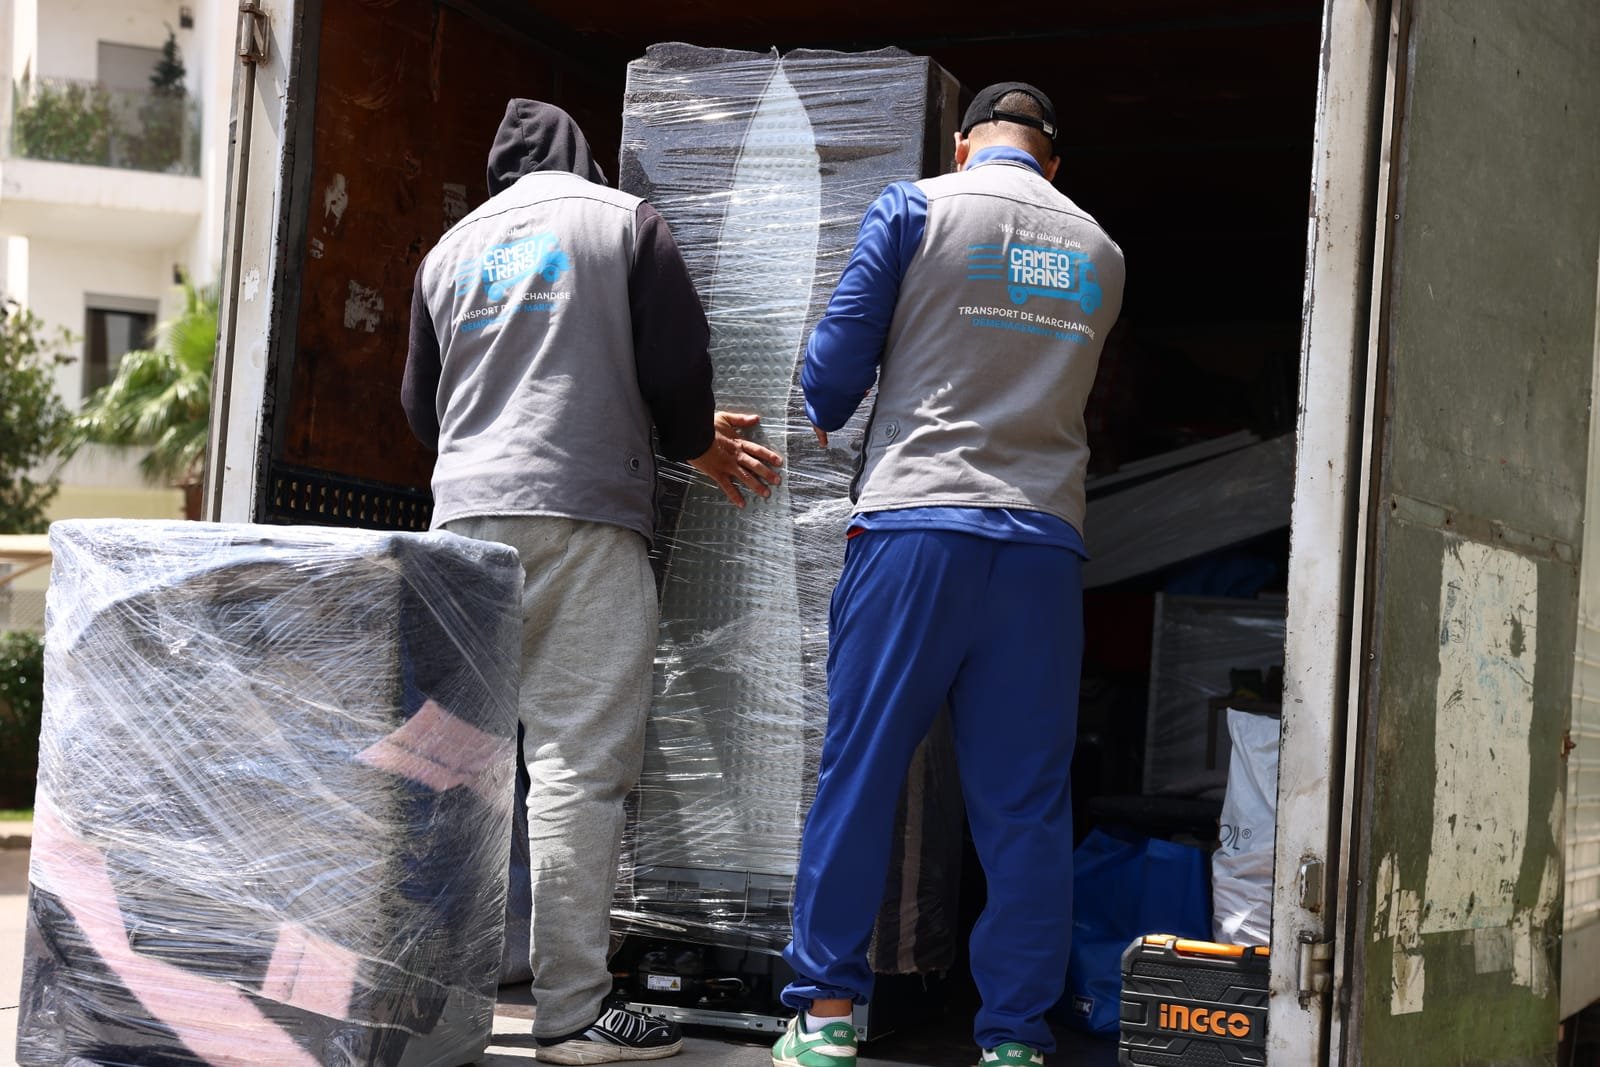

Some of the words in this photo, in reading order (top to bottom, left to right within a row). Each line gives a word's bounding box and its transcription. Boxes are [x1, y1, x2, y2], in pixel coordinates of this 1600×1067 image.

[1015, 228, 1035, 239] care
[1037, 232, 1063, 245] about
[1064, 239, 1081, 249] you
[1010, 247, 1070, 272] CAMEO
[1010, 264, 1071, 289] TRANS
[958, 306, 1019, 319] TRANSPORT
[1020, 311, 1034, 321] DE
[832, 1029, 849, 1038] NIKE
[1007, 1049, 1024, 1058] NIKE
